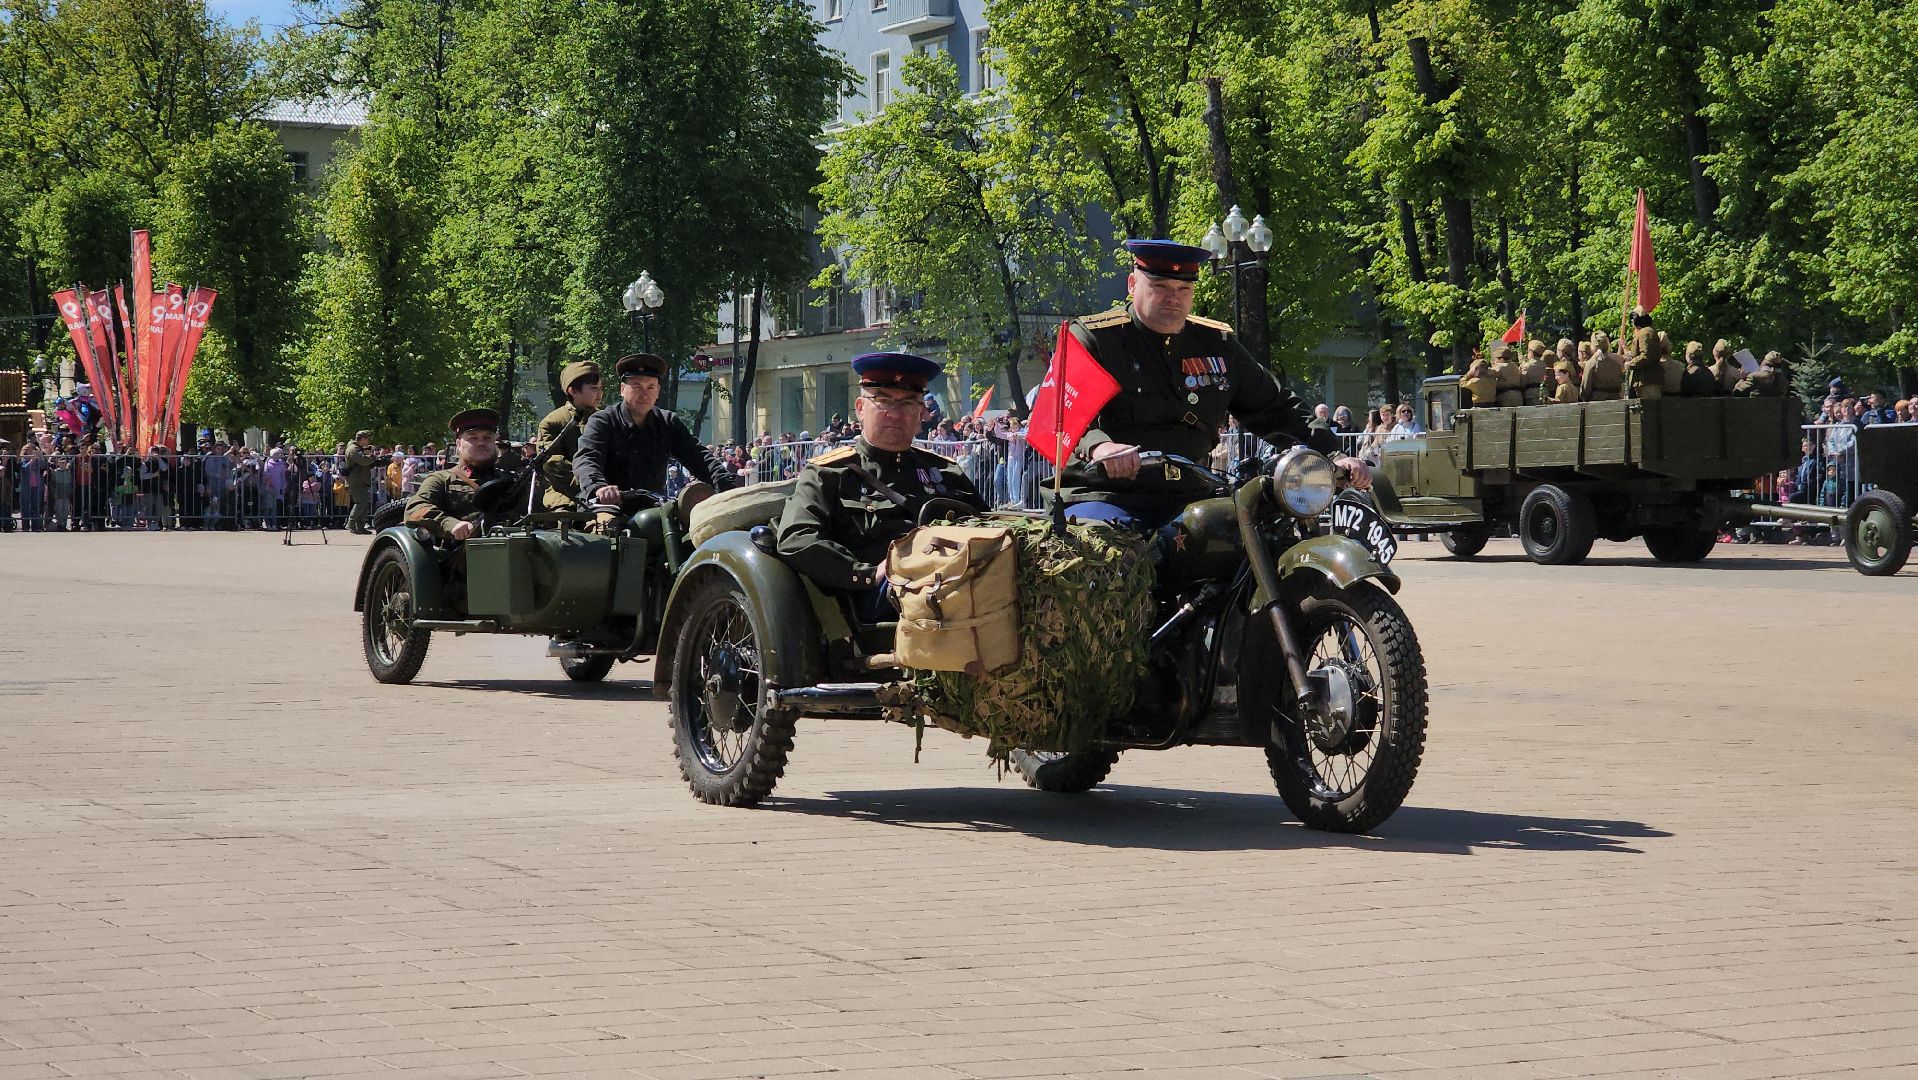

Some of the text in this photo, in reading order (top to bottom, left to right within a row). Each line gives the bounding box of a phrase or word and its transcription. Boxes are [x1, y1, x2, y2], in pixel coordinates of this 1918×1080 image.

[170, 293, 183, 310] 9
[193, 301, 208, 318] 9
[152, 305, 165, 323] 9
[1367, 520, 1395, 564] 1945
